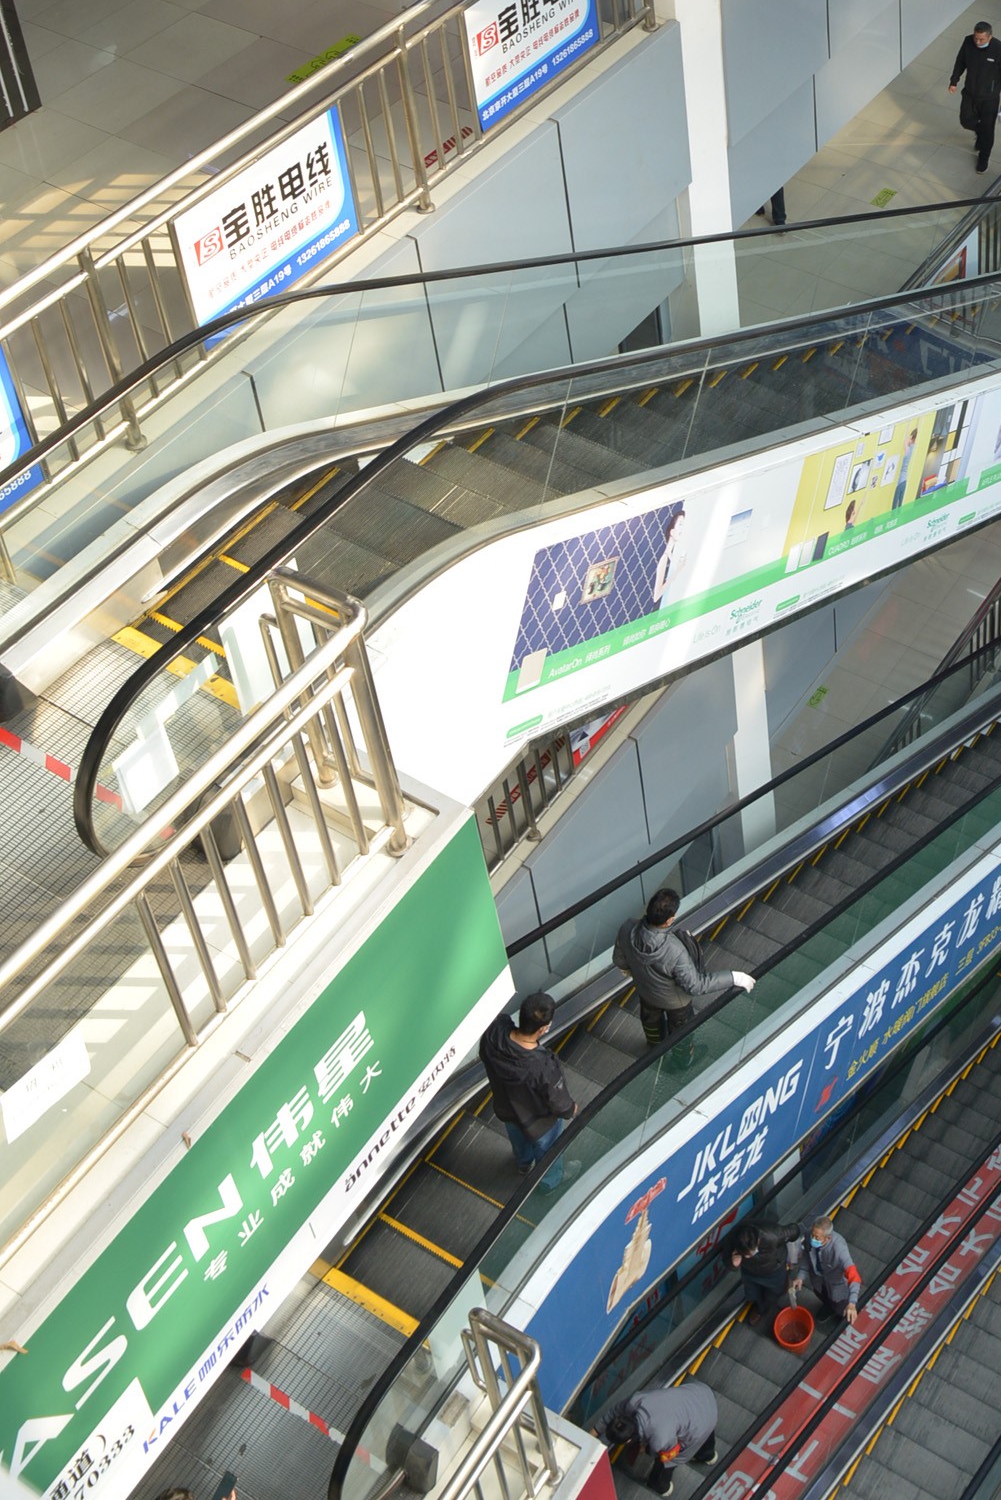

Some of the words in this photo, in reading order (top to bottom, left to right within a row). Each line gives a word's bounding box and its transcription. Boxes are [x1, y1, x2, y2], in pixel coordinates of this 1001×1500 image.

[501, 8, 556, 54] BAOSHENG
[552, 28, 595, 67] 13261865888
[222, 142, 332, 249] 宝胜电线
[229, 202, 299, 260] BAOSHENG
[303, 175, 334, 204] WIRE
[296, 218, 351, 267] 13261865888
[730, 598, 762, 621] Schneider
[203, 1060, 383, 1282] 专业成就伟大
[677, 1058, 804, 1203] JKLONG
[691, 1125, 769, 1226] 杰克龙
[2, 1173, 244, 1480] ASEN
[250, 1010, 375, 1180] 伟星
[143, 1377, 197, 1455] KALE
